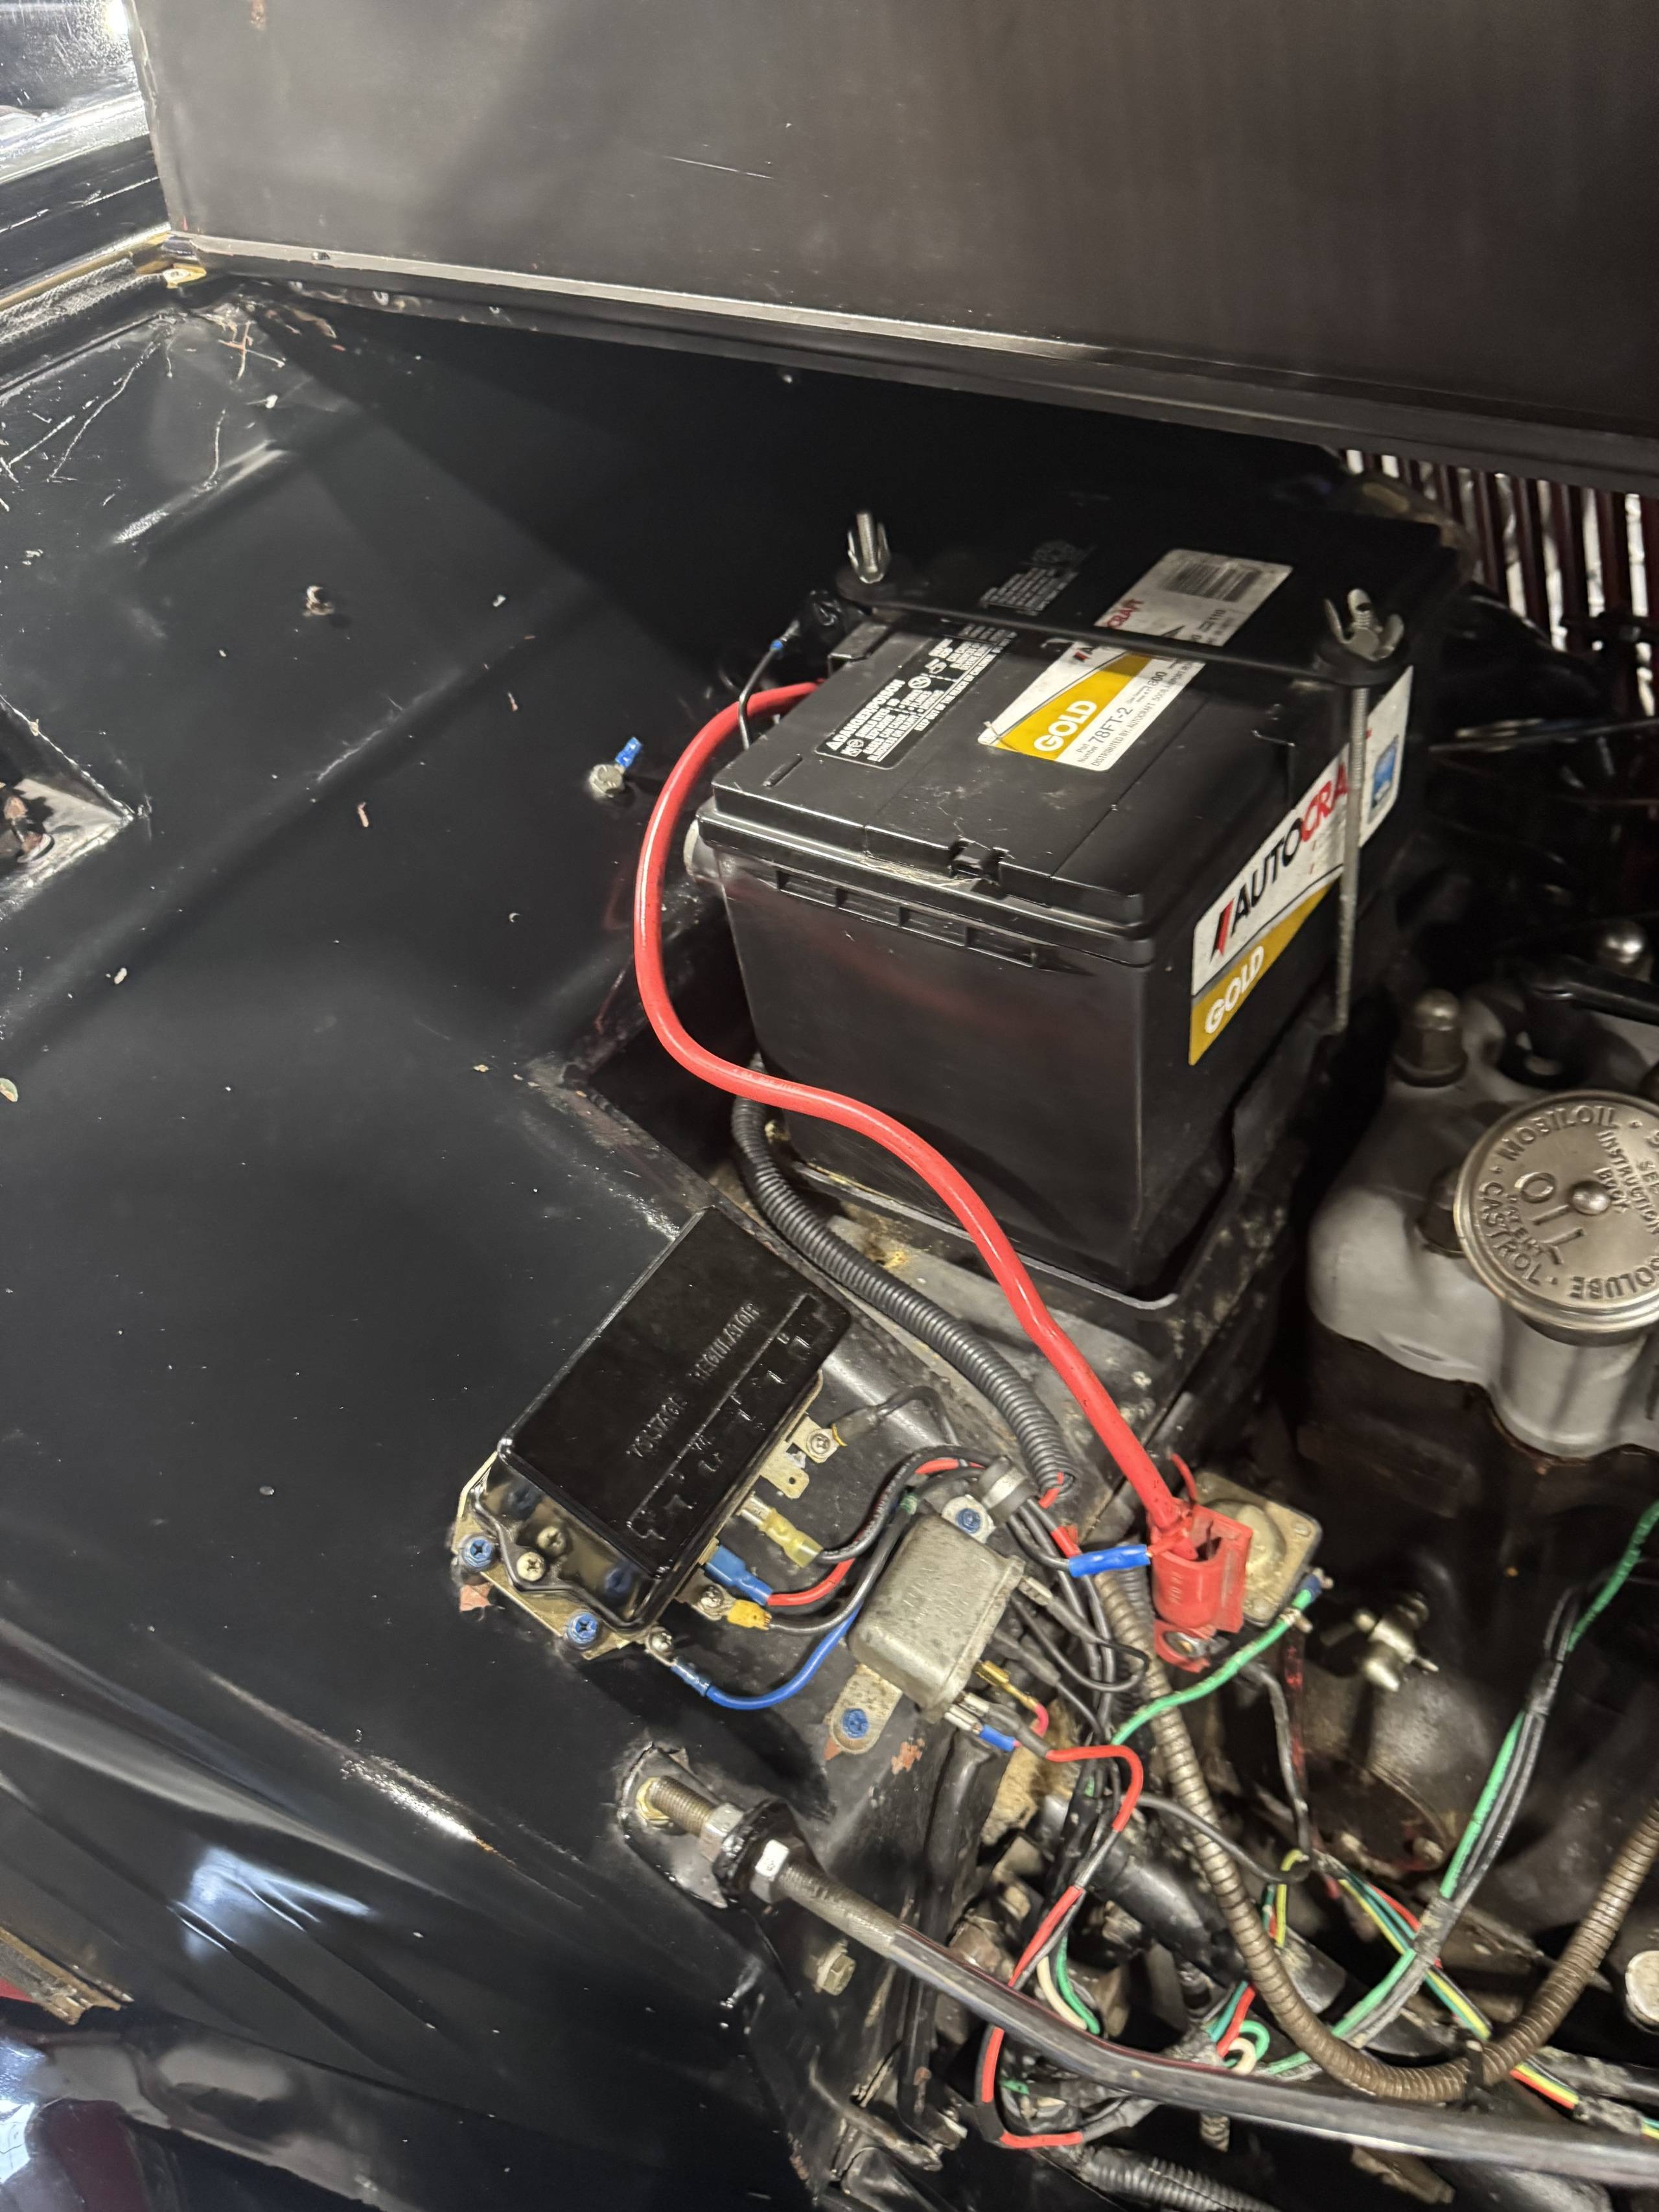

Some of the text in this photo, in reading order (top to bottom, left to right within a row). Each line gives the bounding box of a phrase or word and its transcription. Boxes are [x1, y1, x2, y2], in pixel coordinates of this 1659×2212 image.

[1149, 671, 1166, 687] 800
[912, 718, 933, 731] KEEP
[925, 710, 941, 719] OUT
[940, 695, 956, 704] THE
[1034, 701, 1097, 751] GOLD
[1088, 707, 1133, 744] 78FT-2
[1091, 737, 1124, 766] DISTRIBUTED
[1126, 703, 1155, 728] AUTOCRAFT
[1204, 945, 1265, 1034] GOLD
[1496, 1105, 1619, 1162] MOBILOIL
[1593, 1167, 1631, 1213] BOOK
[1479, 1182, 1541, 1286] CASTROL
